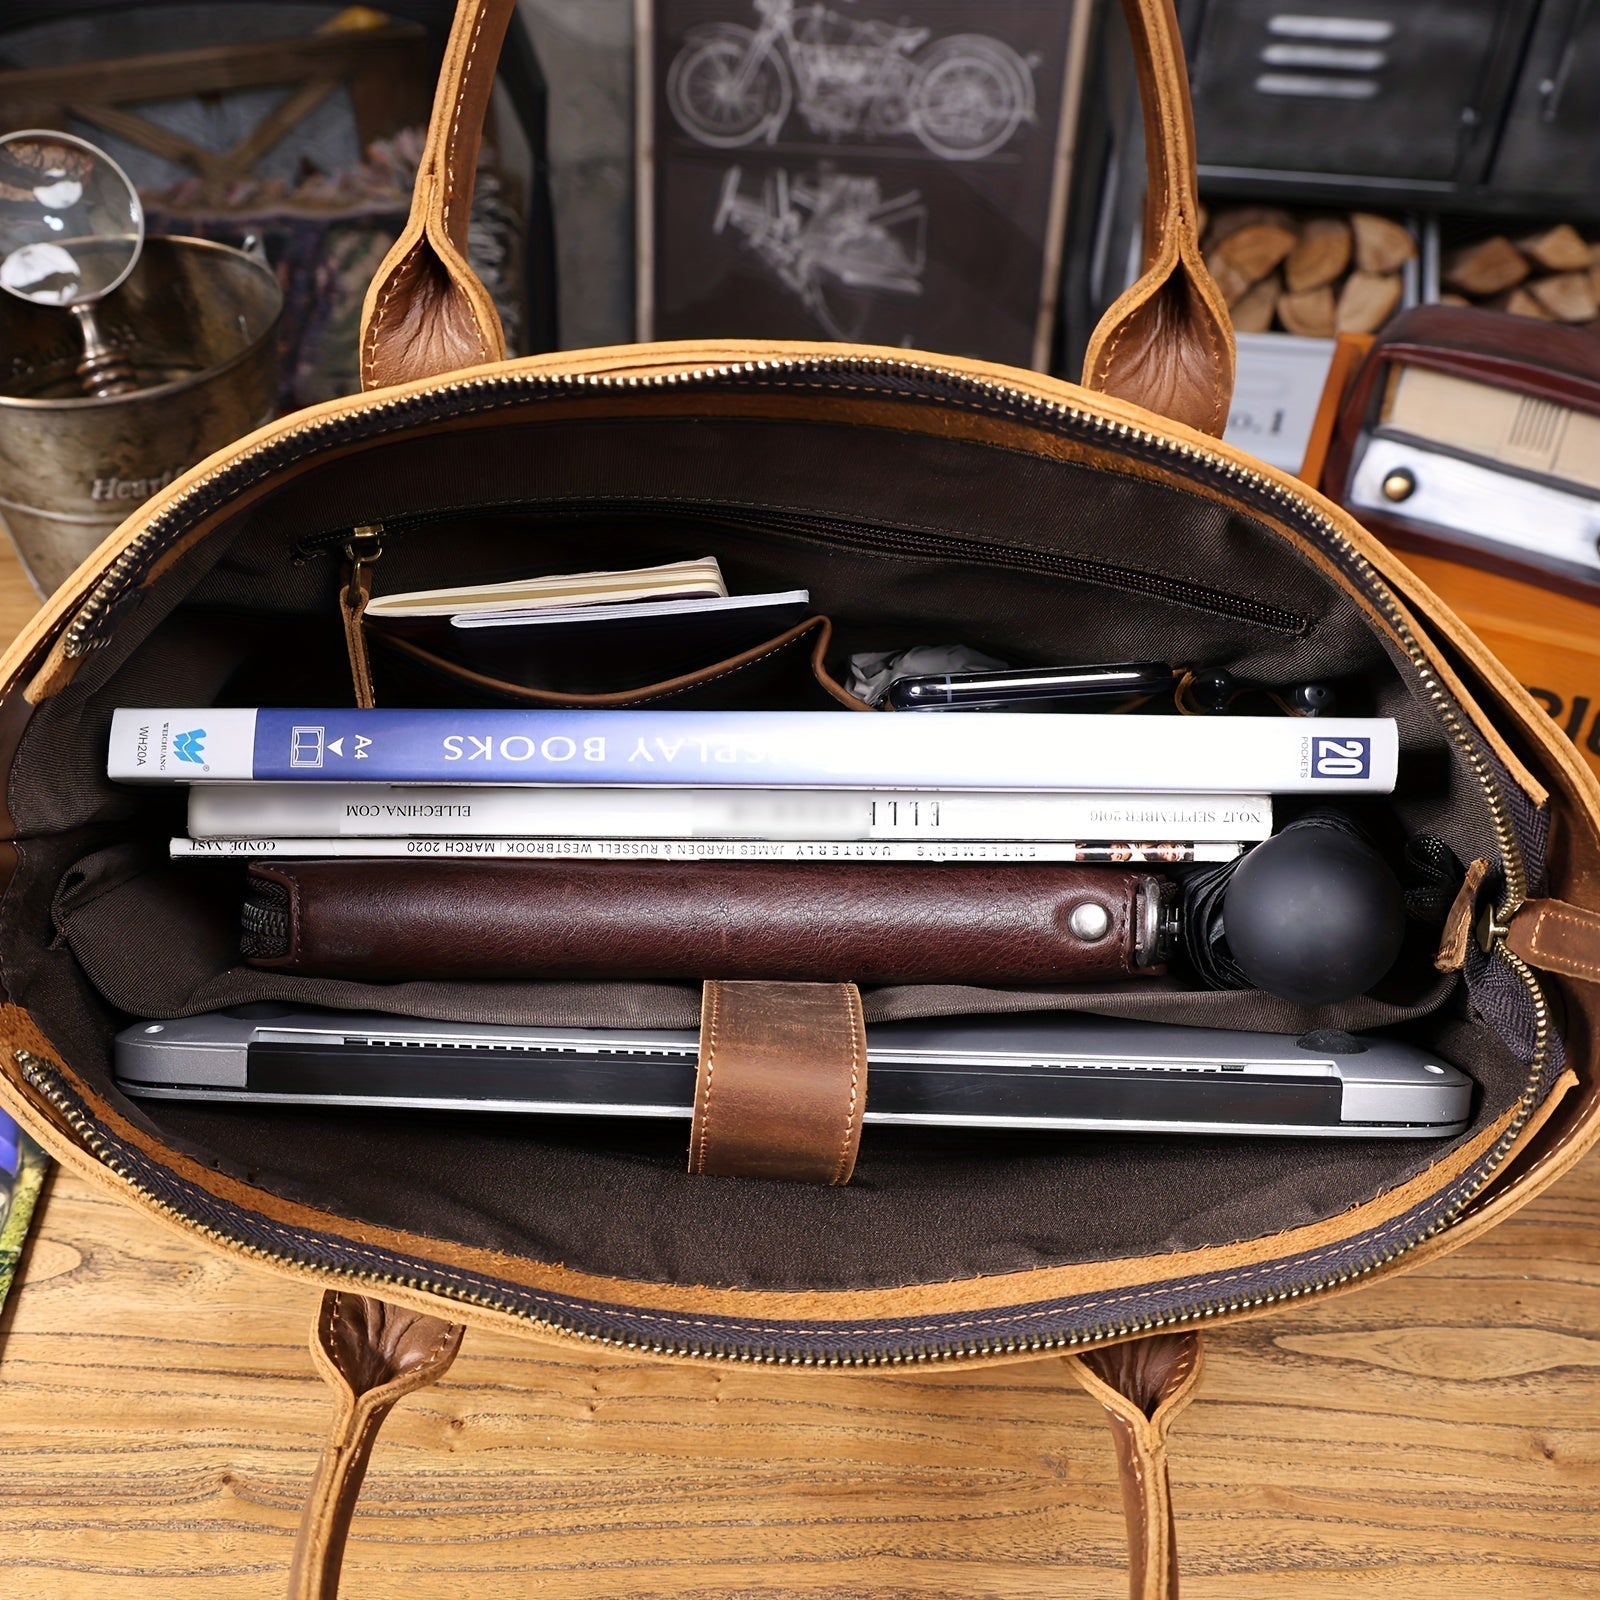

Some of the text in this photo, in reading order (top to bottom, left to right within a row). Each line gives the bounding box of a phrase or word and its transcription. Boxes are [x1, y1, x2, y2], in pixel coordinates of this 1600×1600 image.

[136, 725, 150, 767] WH20A
[159, 721, 170, 771] WEICHUANG
[354, 734, 373, 760] A4
[443, 734, 606, 763] BOOKS
[1299, 736, 1309, 778] POCKETS
[1316, 740, 1364, 775] 20
[346, 804, 472, 818] ELLECHINA.COM
[1090, 811, 1263, 824] NO.17 SEPTEMBER 2016
[189, 840, 276, 855] CONDÉ NAST
[406, 841, 1037, 858] ENTLEMEN'S UARTERLY JAMES HARDEN & RUSSELL WESTBROOK MARCH 2020
